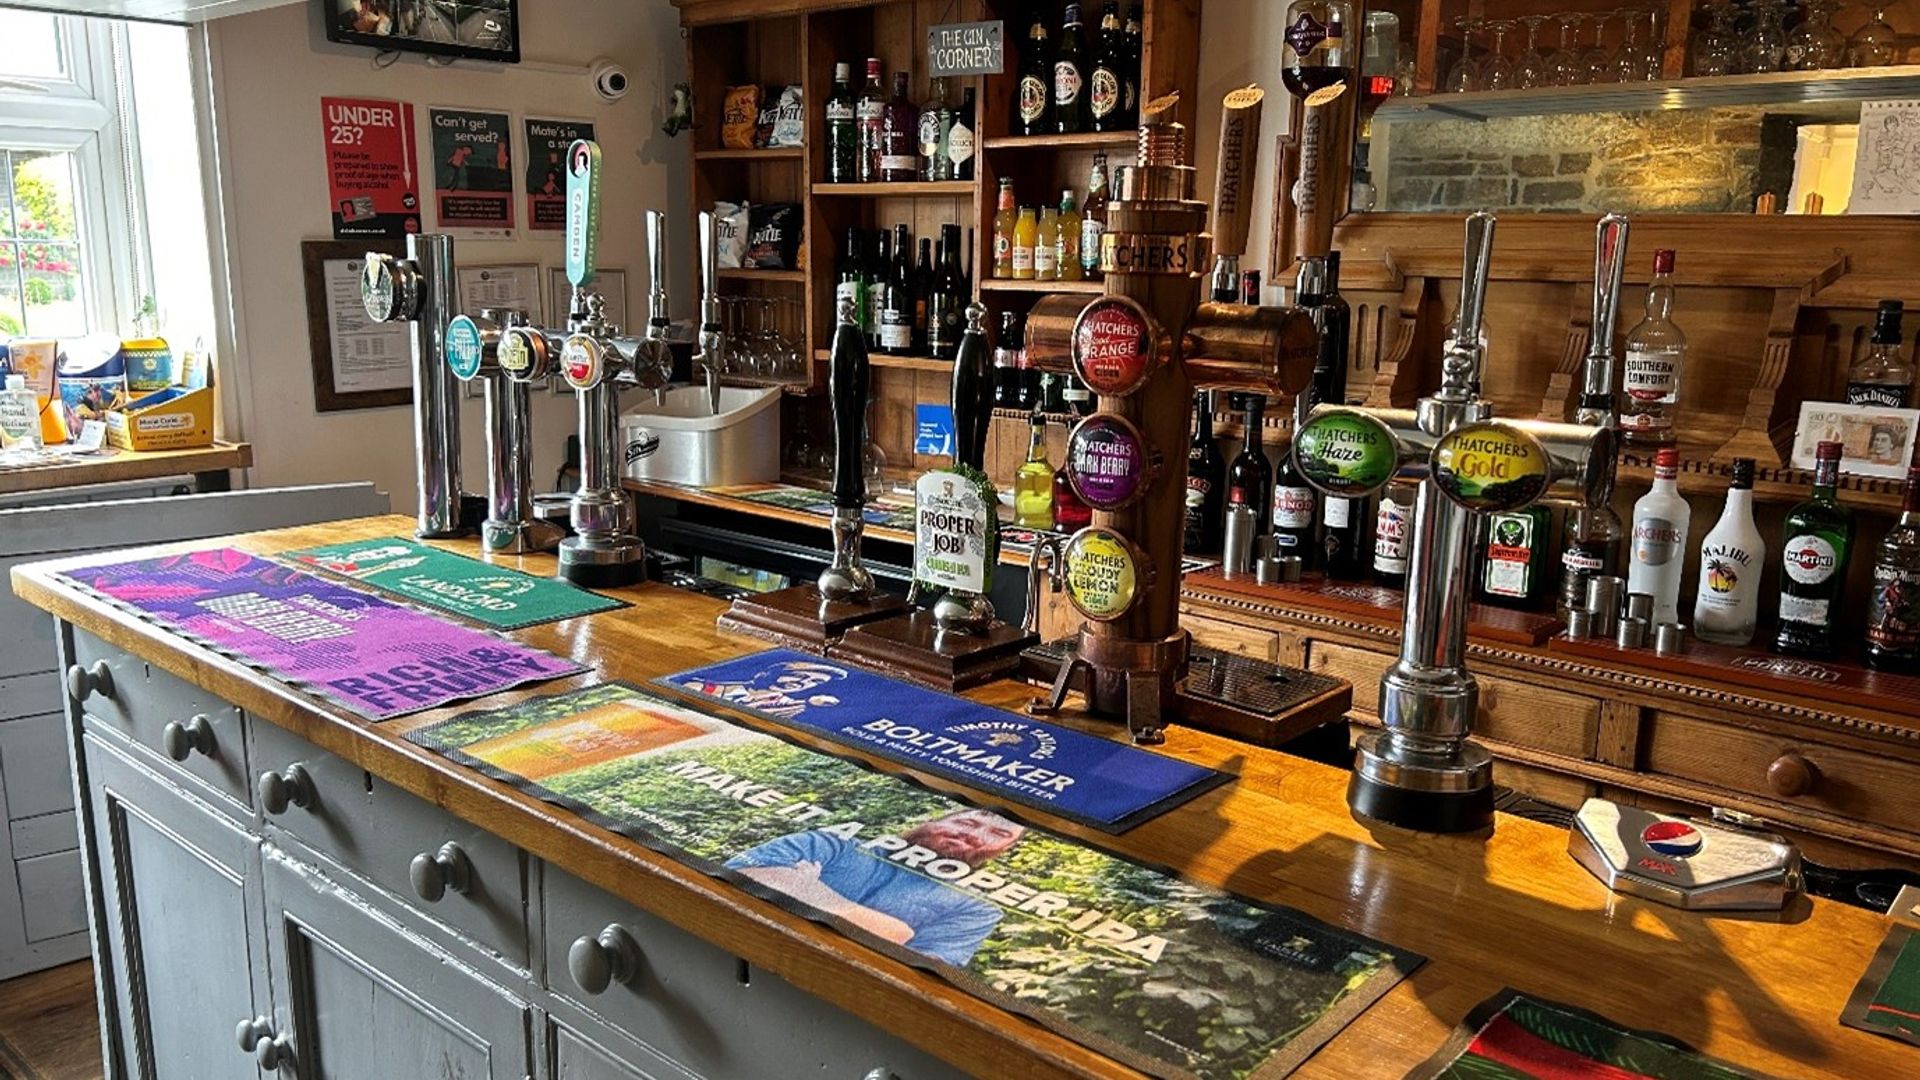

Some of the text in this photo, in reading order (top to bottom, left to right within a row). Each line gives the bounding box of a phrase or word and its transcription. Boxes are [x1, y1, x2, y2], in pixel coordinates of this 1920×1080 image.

[940, 28, 984, 46] THE GIN
[936, 46, 993, 69] CORNER
[328, 105, 396, 127] UNDER
[435, 115, 488, 131] Can't get
[330, 125, 364, 146] 25?
[454, 131, 499, 144] served?
[530, 124, 577, 138] Mate's in
[547, 140, 556, 149] a
[1218, 116, 1244, 217] THATCHERS
[572, 193, 582, 258] CAMDEN
[1627, 360, 1675, 374] SOUTHERN
[1628, 372, 1670, 386] COMFORT
[1312, 425, 1378, 446] THATCHERS
[1316, 440, 1365, 461] Haze
[1452, 436, 1529, 458] THATCHERS
[1100, 455, 1131, 477] BERRY
[1459, 452, 1511, 479] Gold
[920, 511, 975, 535] PROPER
[933, 532, 961, 553] JOB
[1074, 551, 1126, 570] ATCHERS
[1702, 544, 1753, 568] MALIBU
[1785, 550, 1834, 568] MARTINI
[1073, 562, 1121, 581] CLOUDY
[399, 574, 518, 612] LANDLORD
[1073, 574, 1119, 595] LEMON
[327, 655, 477, 696] RICH
[359, 656, 552, 711] FRUITY
[944, 721, 1029, 734] TIMOTHY
[840, 725, 1058, 800] BOLD & MALTY YORKSHIRE BITTER
[862, 717, 1076, 793] BOLTMAKER
[661, 759, 1169, 965] MAKE IT A PROPER IPA
[1637, 856, 1678, 876] MAX
